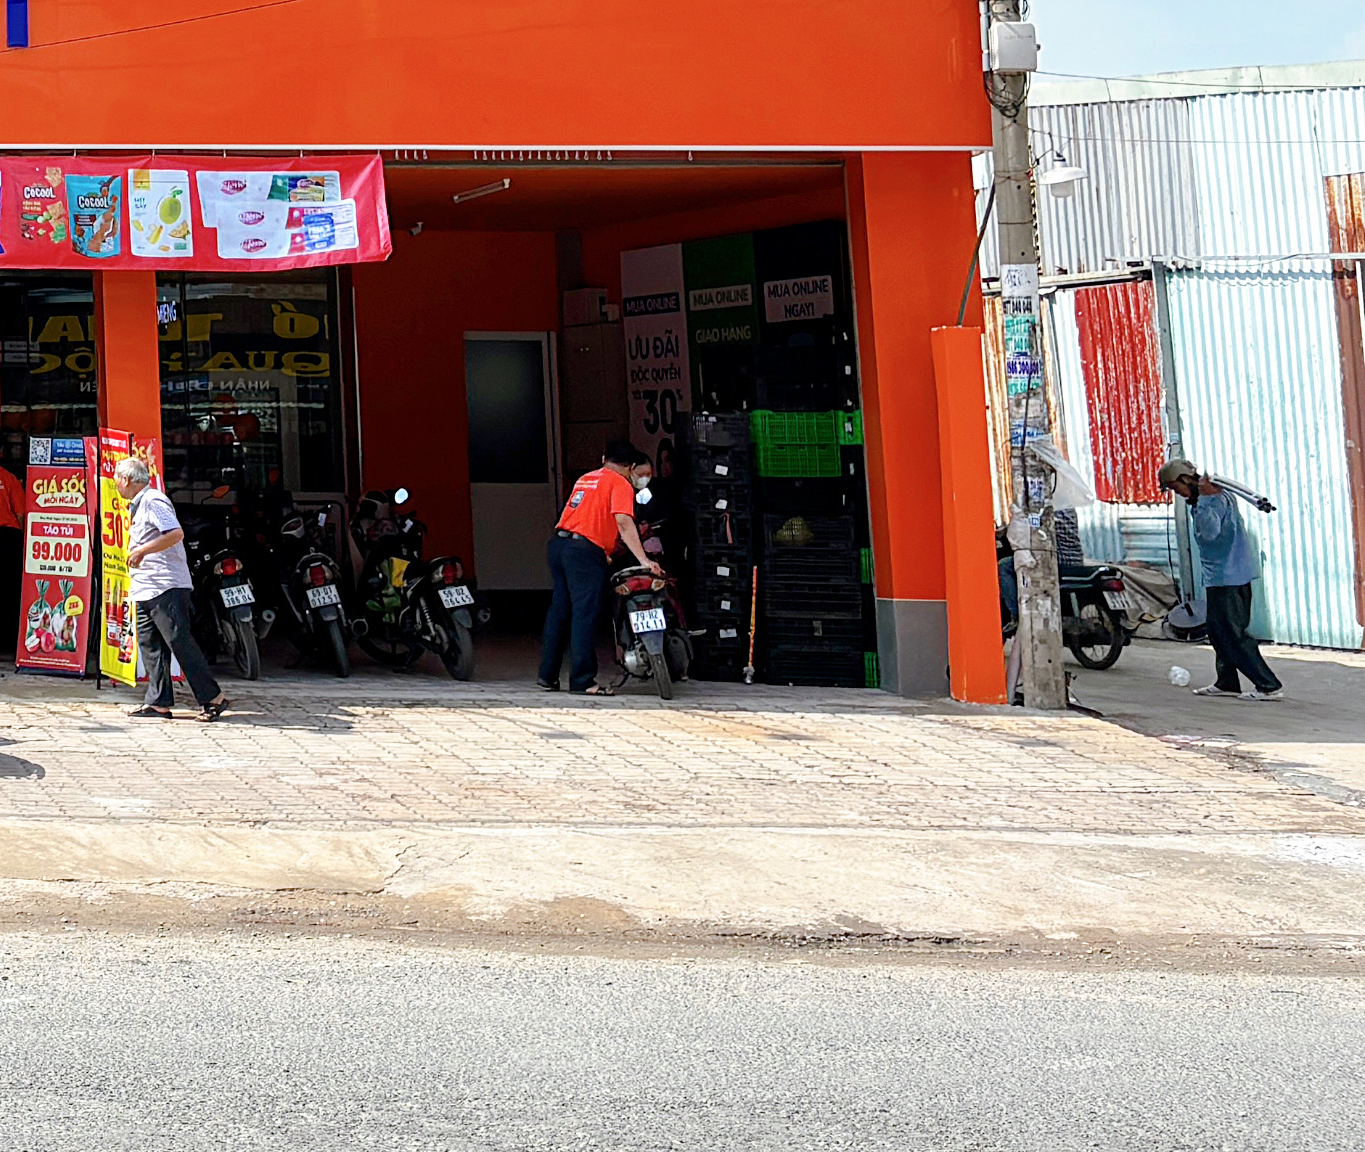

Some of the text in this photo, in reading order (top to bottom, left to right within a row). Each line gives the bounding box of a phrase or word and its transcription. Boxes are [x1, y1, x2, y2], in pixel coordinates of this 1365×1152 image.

[715, 288, 749, 304] ONLINE
[768, 278, 829, 299] MUA ONLINE
[32, 474, 59, 495] GIÁ
[42, 523, 74, 536] TÁO TÚI
[32, 540, 83, 563] 99.000
